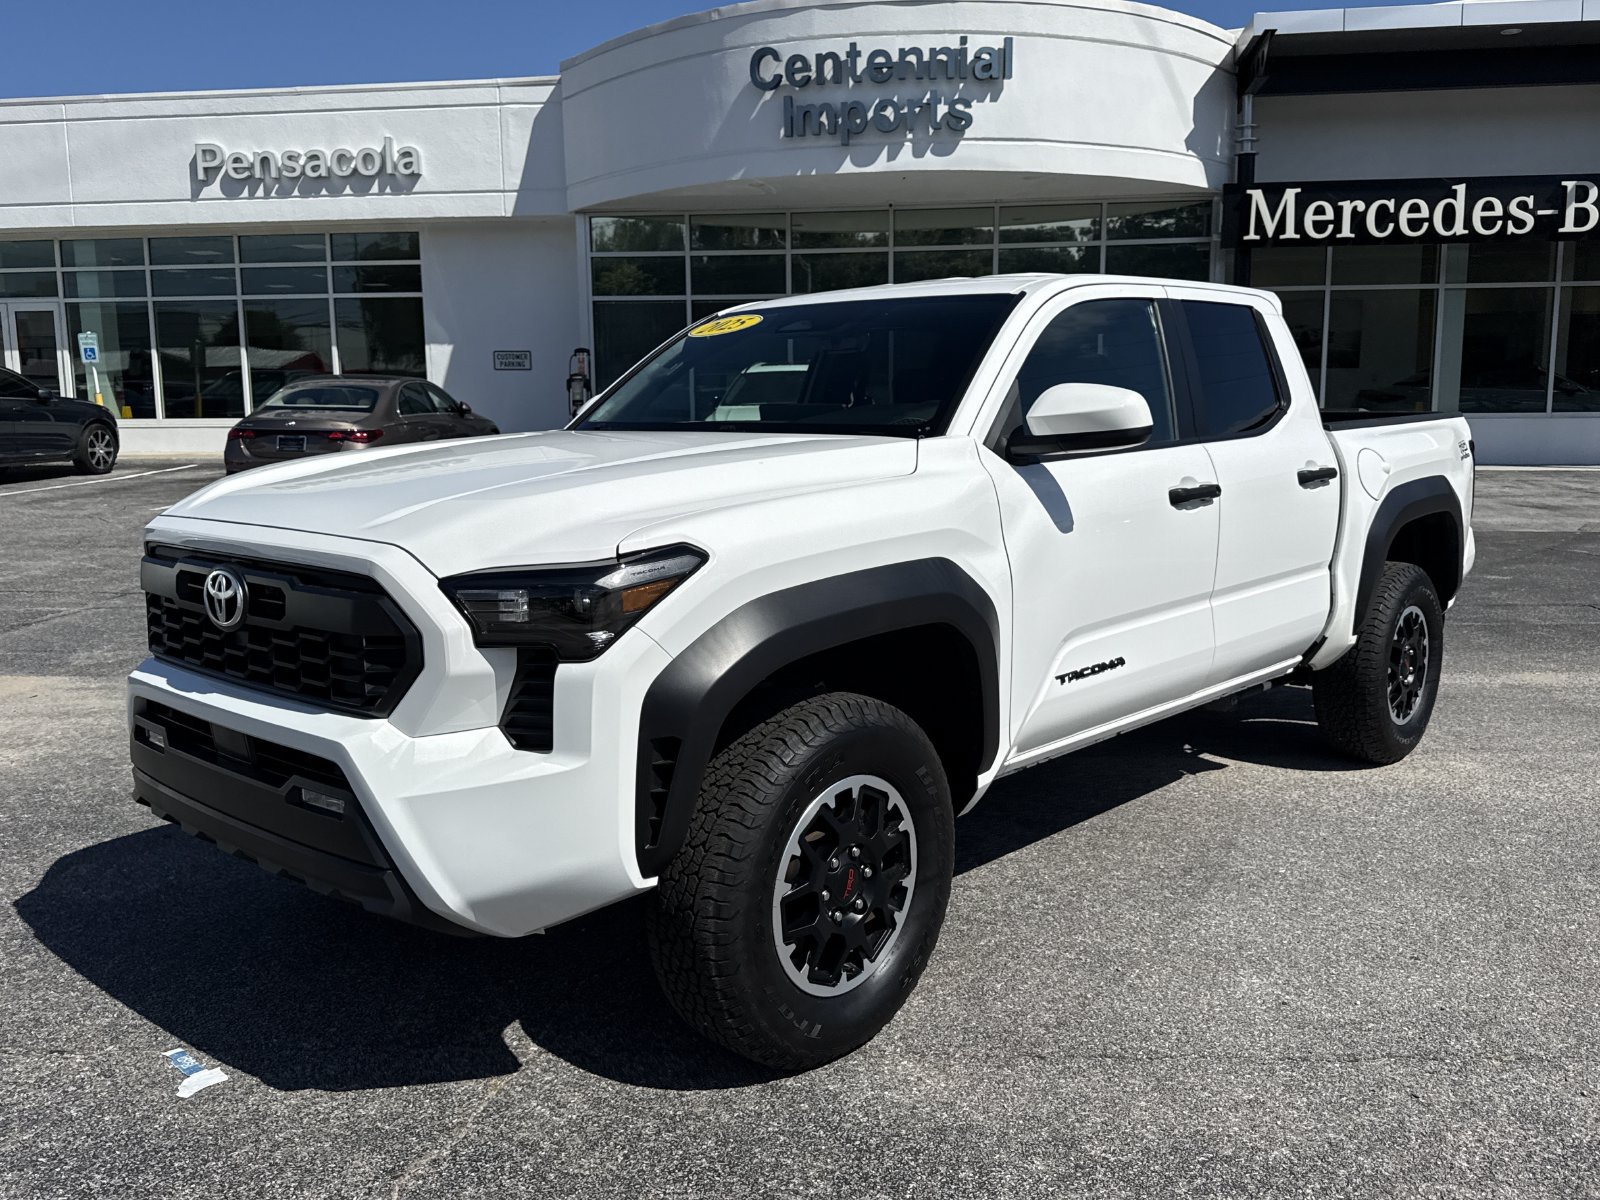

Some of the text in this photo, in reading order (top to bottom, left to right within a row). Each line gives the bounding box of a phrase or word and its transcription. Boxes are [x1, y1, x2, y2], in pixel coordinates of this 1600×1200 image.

[750, 36, 1013, 91] Centennial
[783, 90, 974, 146] Imports
[195, 136, 422, 181] Pensacola
[1243, 180, 1600, 240] Mercedes-B
[496, 353, 529, 361] CUSTOMER
[630, 566, 666, 576] TACOMA
[1055, 656, 1126, 685] TACOMA
